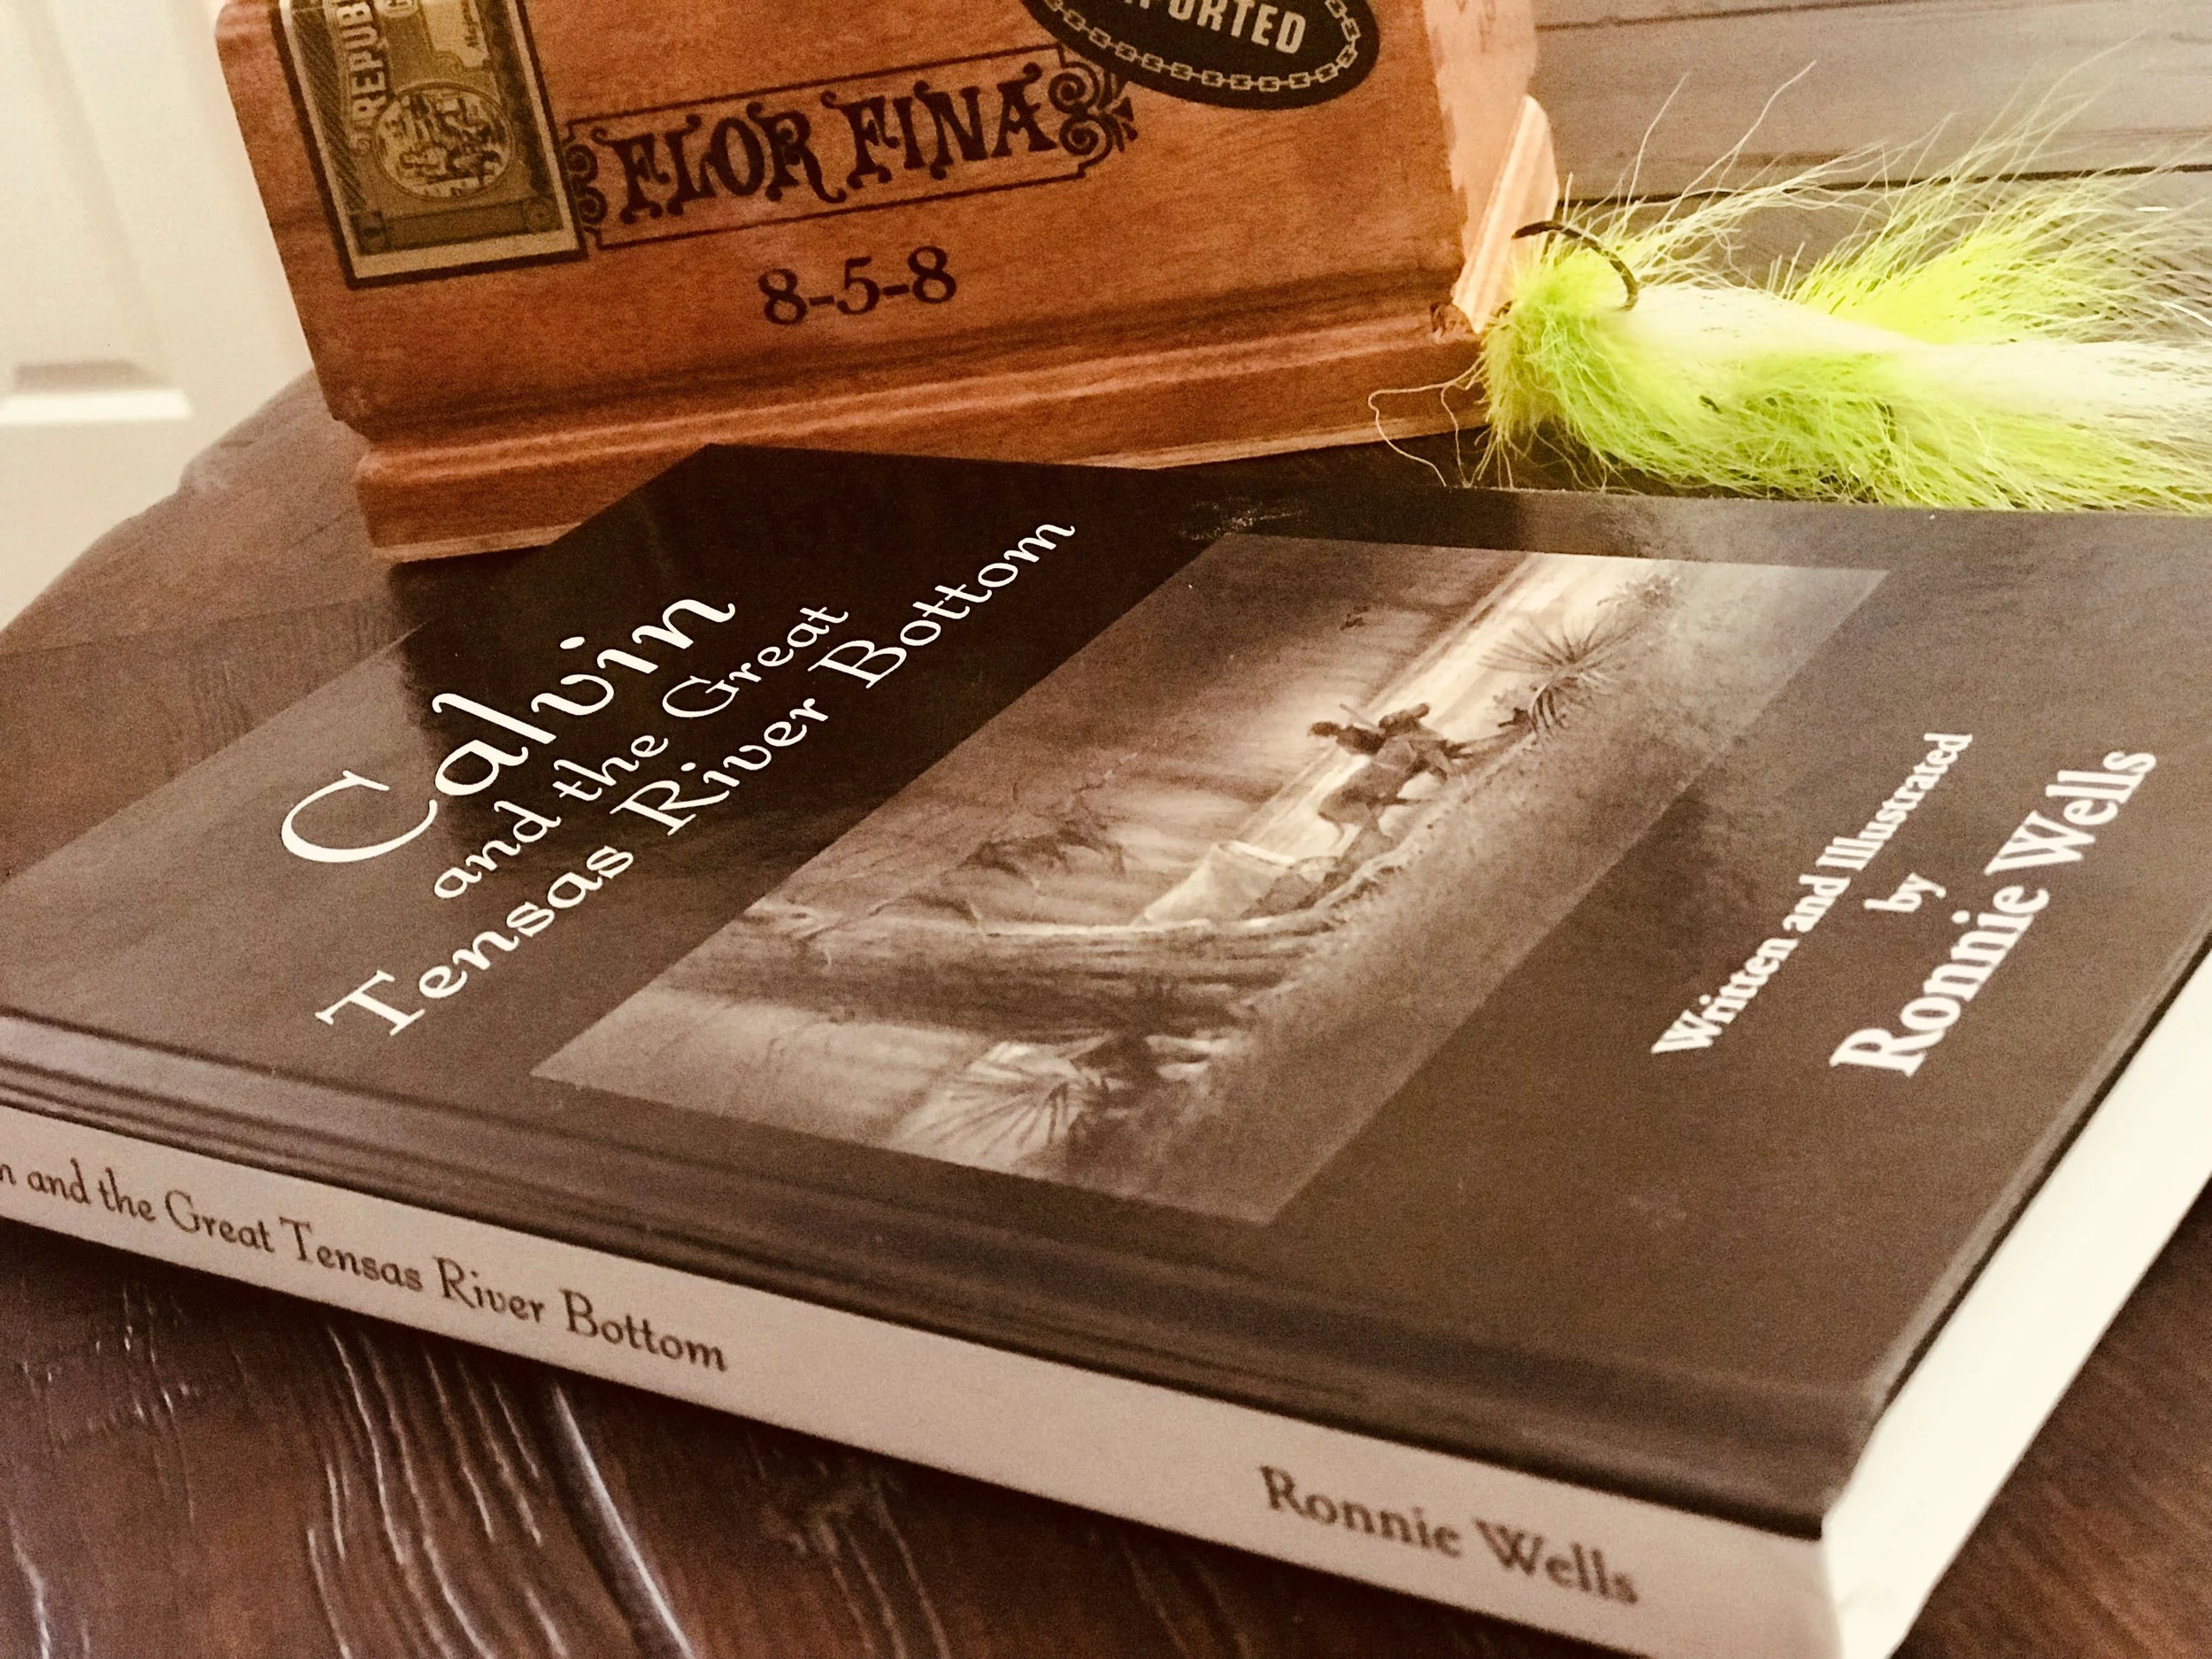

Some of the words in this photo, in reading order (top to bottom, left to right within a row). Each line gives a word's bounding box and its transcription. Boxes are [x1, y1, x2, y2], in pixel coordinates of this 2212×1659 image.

[335, 0, 387, 125] REPUB
[1124, 0, 1307, 54] ORTED
[593, 101, 847, 225] FLOR
[821, 62, 1058, 190] FINA
[757, 245, 957, 326] 8-5-8
[280, 597, 736, 863] Calvin
[315, 841, 635, 1037] Tensas
[610, 697, 831, 836] River
[808, 519, 1076, 689] Bottom
[433, 803, 563, 900] and
[552, 733, 670, 804] the
[661, 604, 849, 721] Great
[1816, 733, 1973, 871] Illustrated
[1782, 874, 1851, 933] and
[1829, 885, 2050, 1078] Ronnie
[1984, 750, 2157, 876] Wells
[1863, 872, 1947, 912] by
[1651, 938, 1799, 1055] Written
[27, 1158, 91, 1204] and
[98, 1167, 157, 1222] the
[165, 1190, 276, 1253] Great
[280, 1217, 423, 1293] Tensas
[433, 1256, 545, 1324] River
[559, 1289, 728, 1372] Bottom
[1260, 1465, 1462, 1558] Ronnie
[1471, 1517, 1640, 1605] Wells
